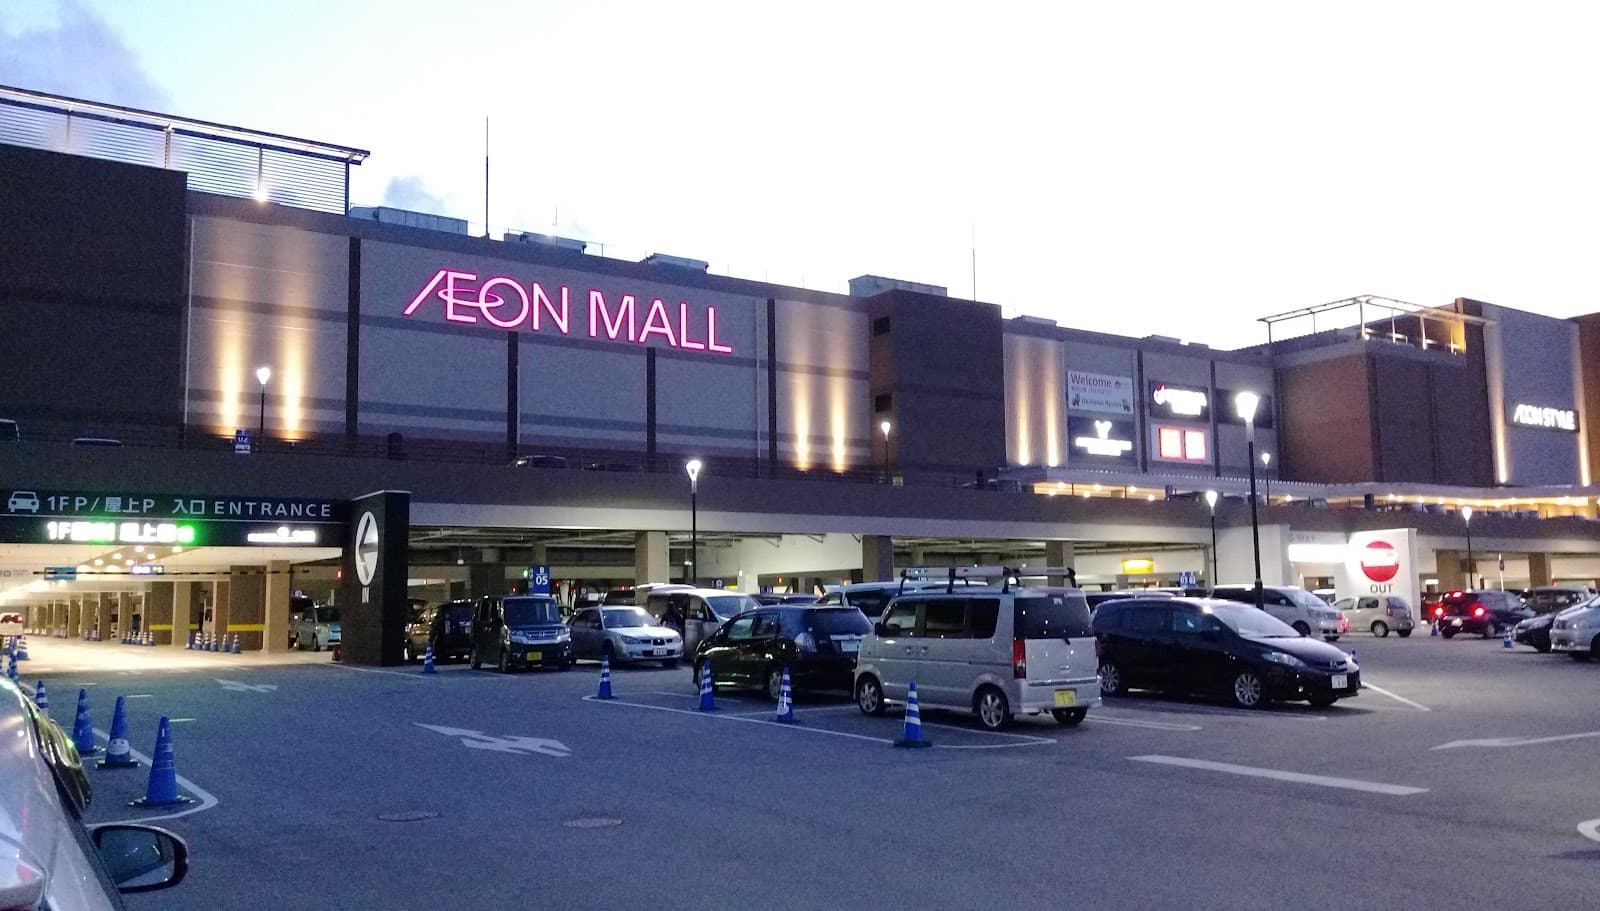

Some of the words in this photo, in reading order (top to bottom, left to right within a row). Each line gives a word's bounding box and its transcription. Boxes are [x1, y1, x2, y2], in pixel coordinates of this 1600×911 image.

[588, 289, 733, 354] MALL
[1070, 373, 1112, 387] Welcome
[172, 499, 206, 515] 入口
[214, 501, 331, 517] ENTRANCE
[536, 576, 548, 585] 05
[1369, 583, 1393, 594] OUT
